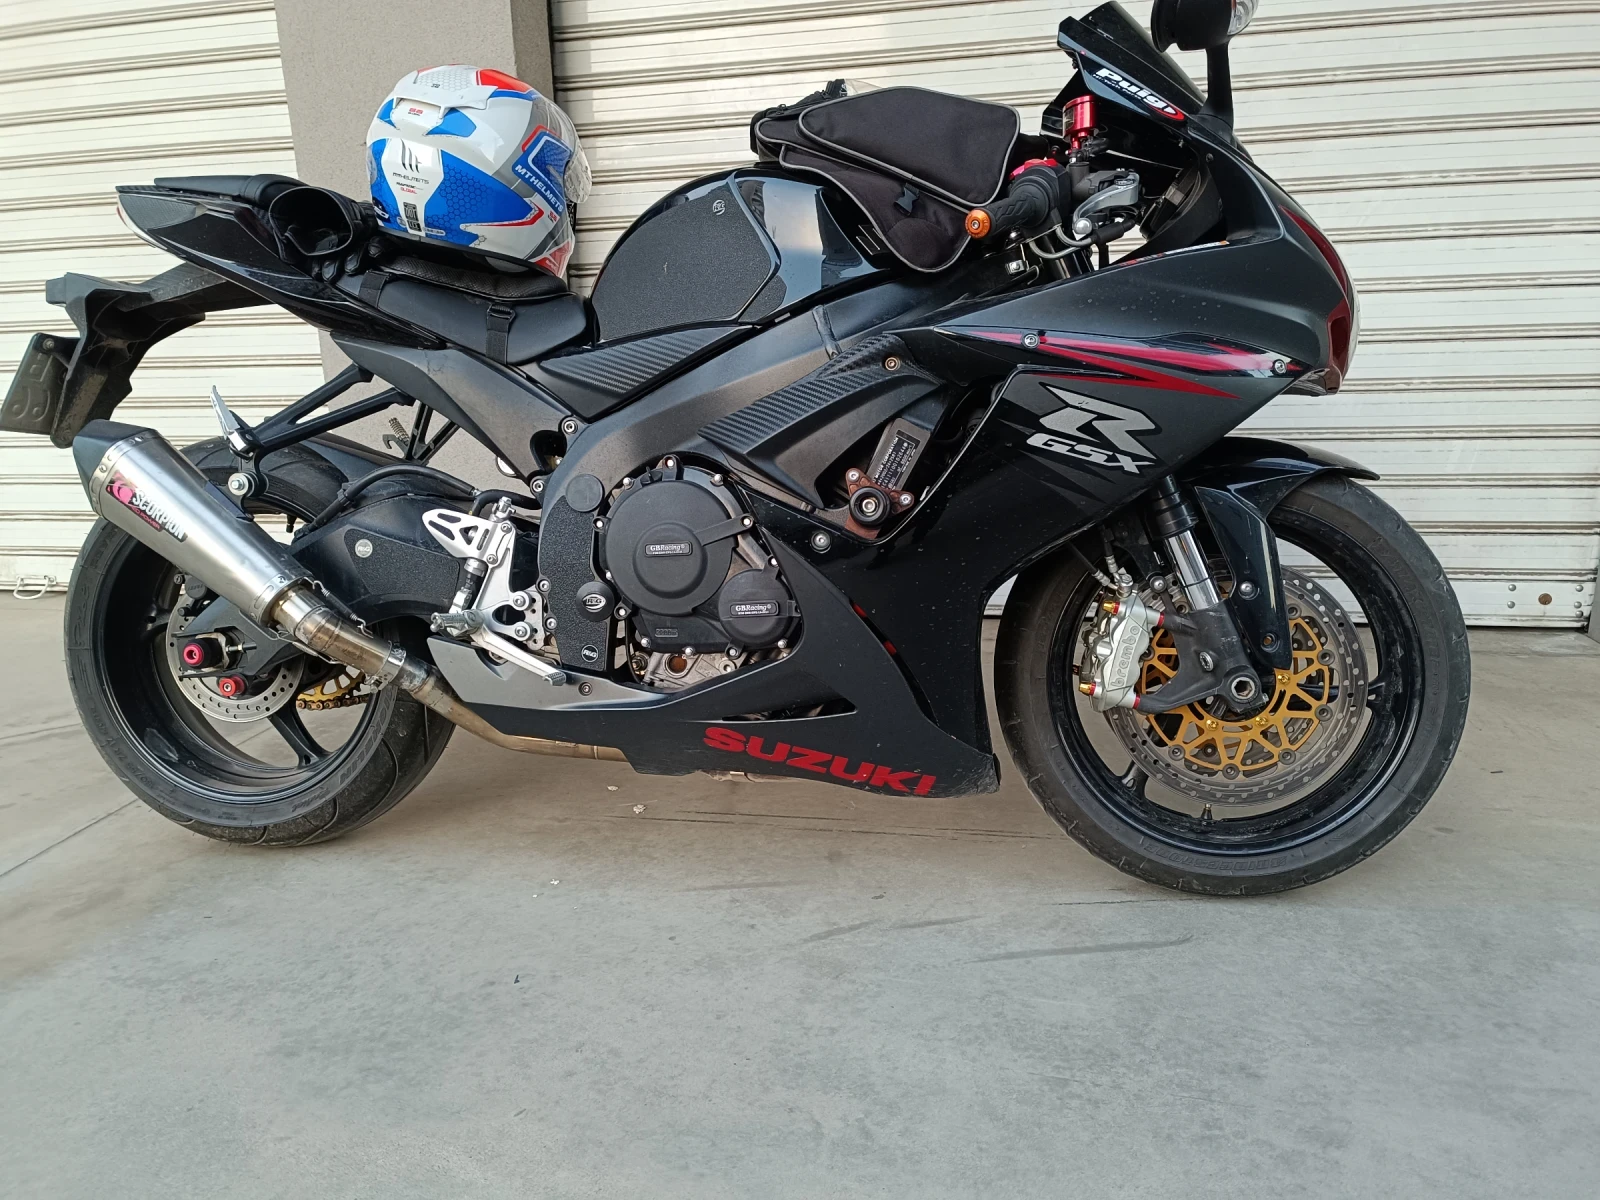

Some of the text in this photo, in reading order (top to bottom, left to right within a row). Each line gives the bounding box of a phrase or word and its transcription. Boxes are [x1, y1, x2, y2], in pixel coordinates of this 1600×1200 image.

[1096, 68, 1168, 108] Puig
[515, 164, 564, 212] MTHELMETS
[881, 436, 899, 464] CORPORATION
[1026, 433, 1155, 474] GSX
[132, 488, 185, 540] SCORPION
[1110, 625, 1141, 688] brembo
[703, 727, 937, 796] SUZUKI
